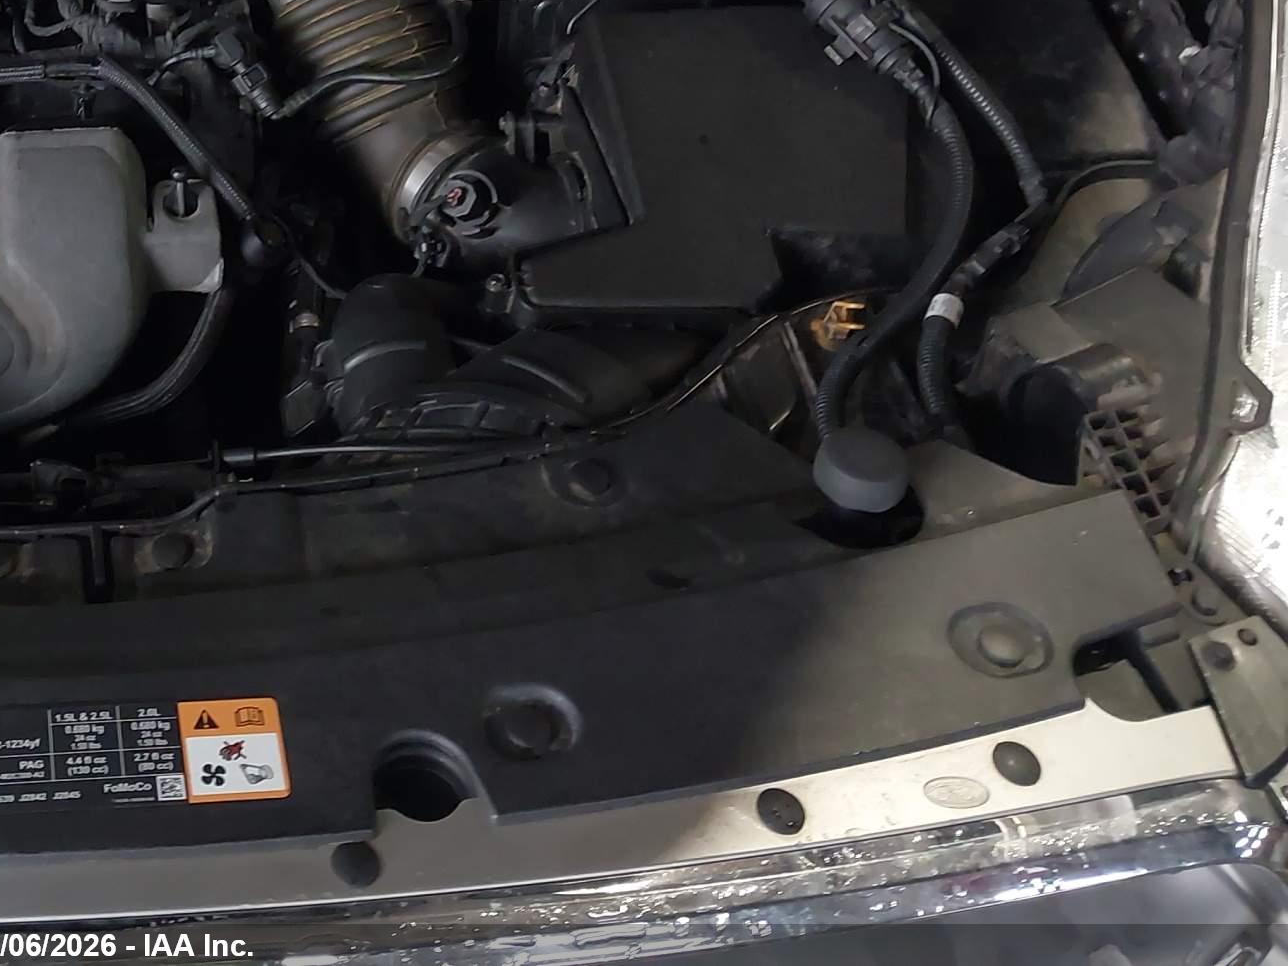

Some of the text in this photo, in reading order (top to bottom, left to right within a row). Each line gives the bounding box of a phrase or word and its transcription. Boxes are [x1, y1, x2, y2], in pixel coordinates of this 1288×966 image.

[79, 712, 89, 721] &
[18, 759, 45, 770] PAG
[103, 781, 153, 794] FoMoCo
